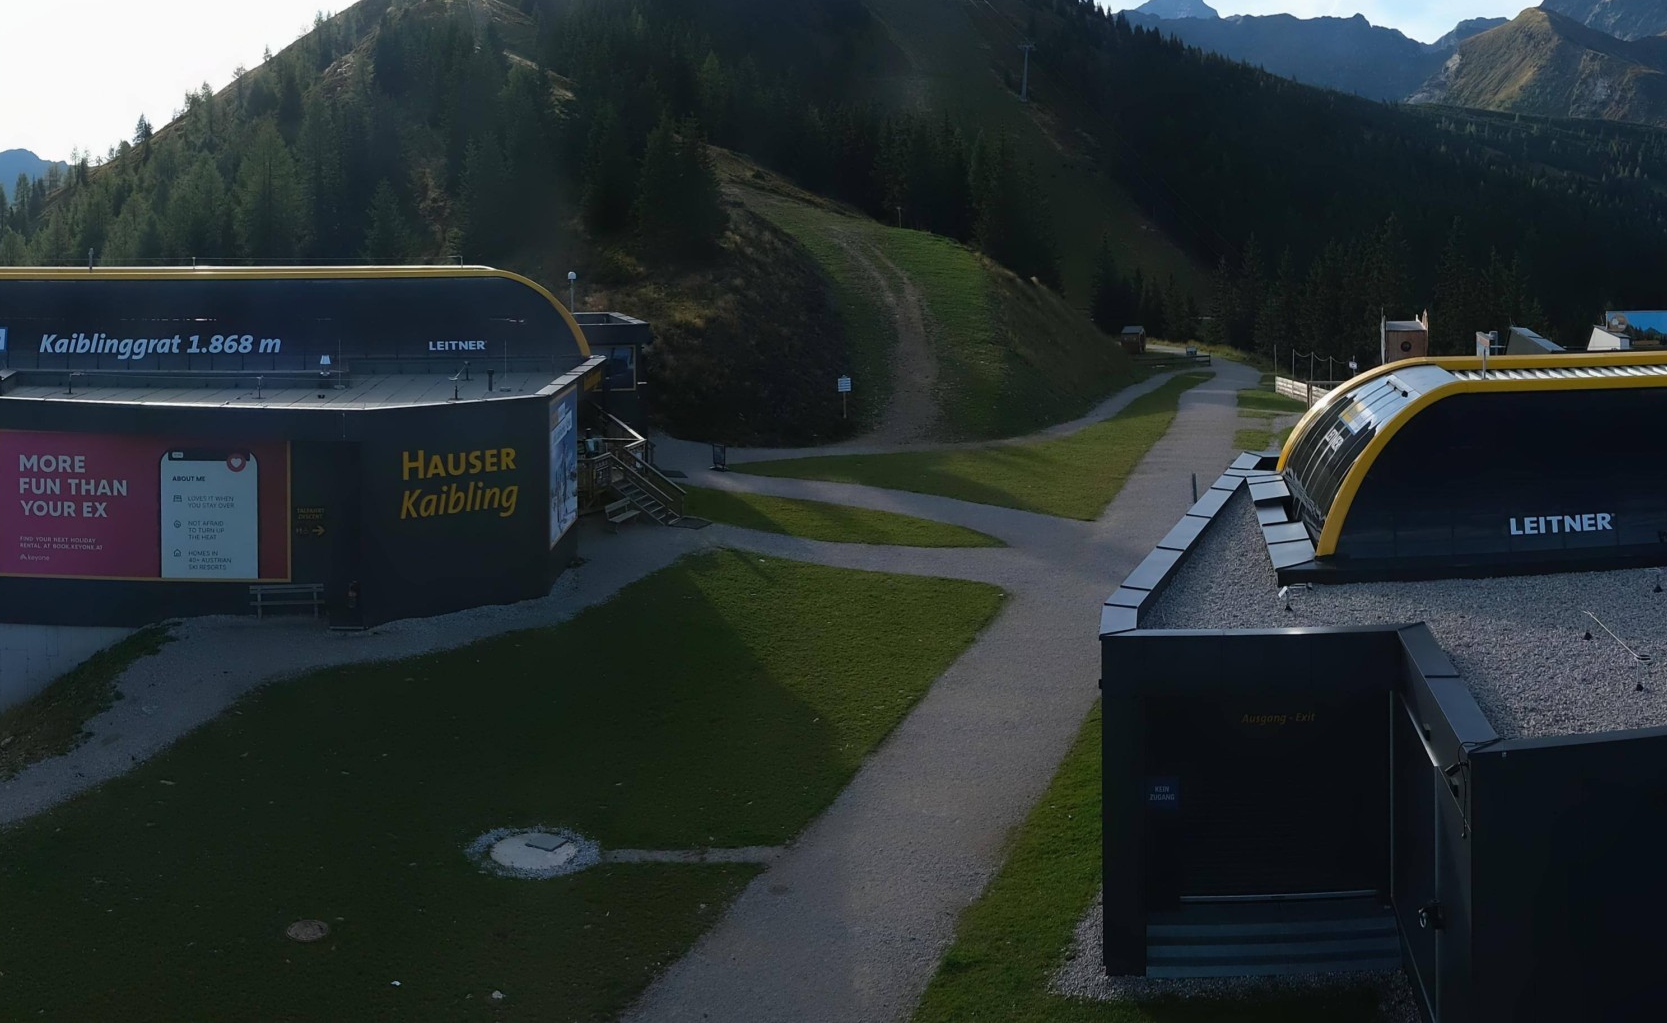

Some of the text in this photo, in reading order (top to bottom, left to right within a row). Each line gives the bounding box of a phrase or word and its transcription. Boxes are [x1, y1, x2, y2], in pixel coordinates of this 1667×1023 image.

[39, 333, 281, 360] Kaiblinggrat 1.868 m
[429, 340, 486, 351] LEITNER
[19, 454, 86, 473] MORE
[402, 448, 516, 480] HAUSER
[20, 478, 127, 496] FUN THAN
[20, 500, 107, 517] YOUR EX
[400, 481, 518, 519] Kaibling
[1510, 513, 1613, 535] LEITNER
[1241, 713, 1287, 725] Ausgang
[1295, 711, 1316, 722] Exit
